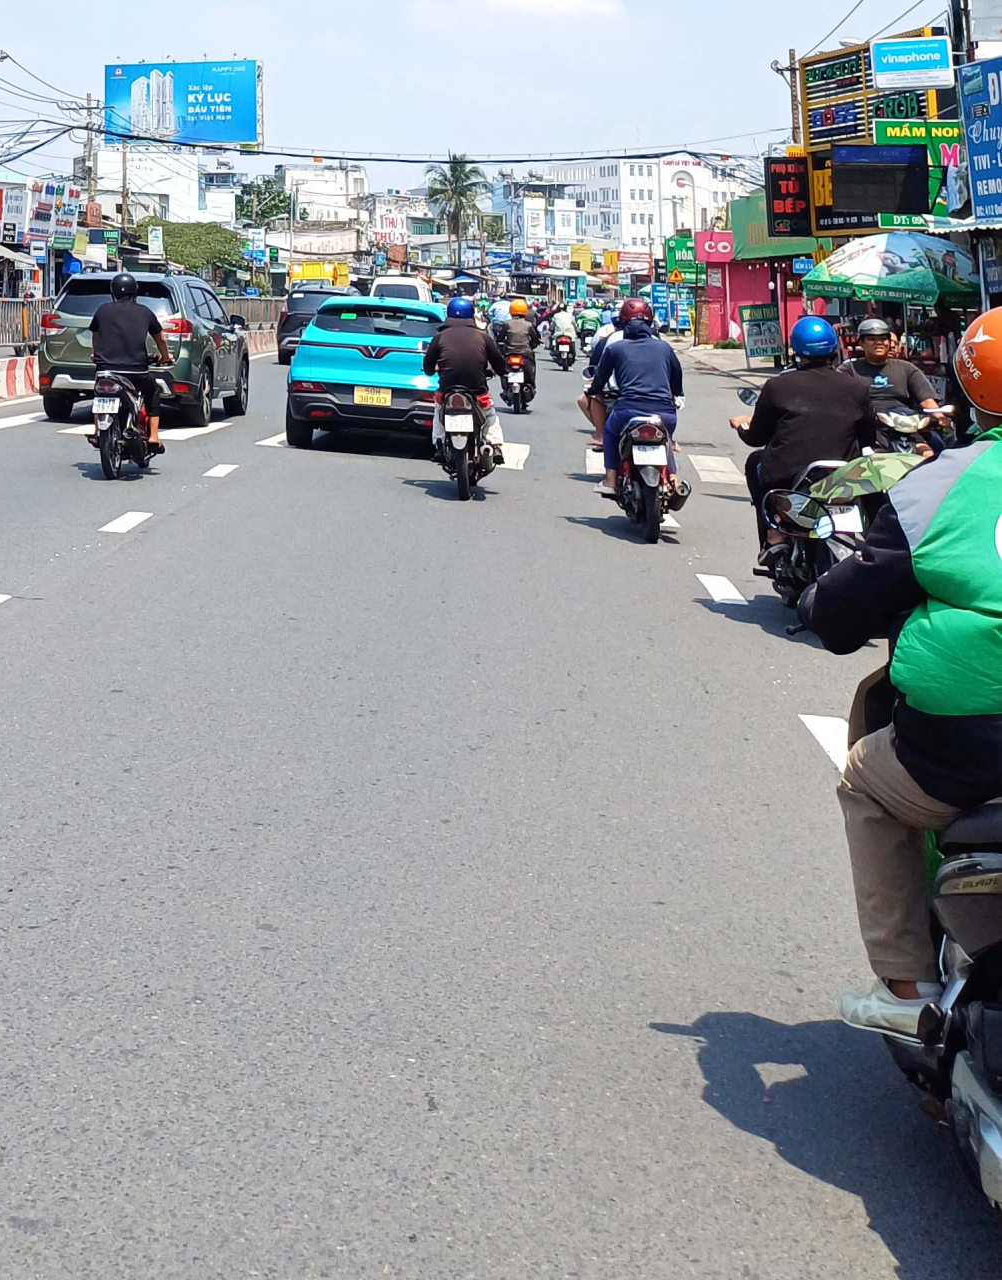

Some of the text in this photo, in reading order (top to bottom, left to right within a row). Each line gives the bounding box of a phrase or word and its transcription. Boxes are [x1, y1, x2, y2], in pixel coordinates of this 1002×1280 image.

[881, 51, 941, 64] vinaphone
[187, 91, 232, 104] KỶ LỤC
[210, 104, 232, 113] TIÊN
[887, 124, 926, 137] MẦM
[973, 154, 991, 171] TIVI
[779, 177, 800, 194] TỦ
[773, 197, 806, 214] BẾP
[749, 346, 768, 356] BÚN
